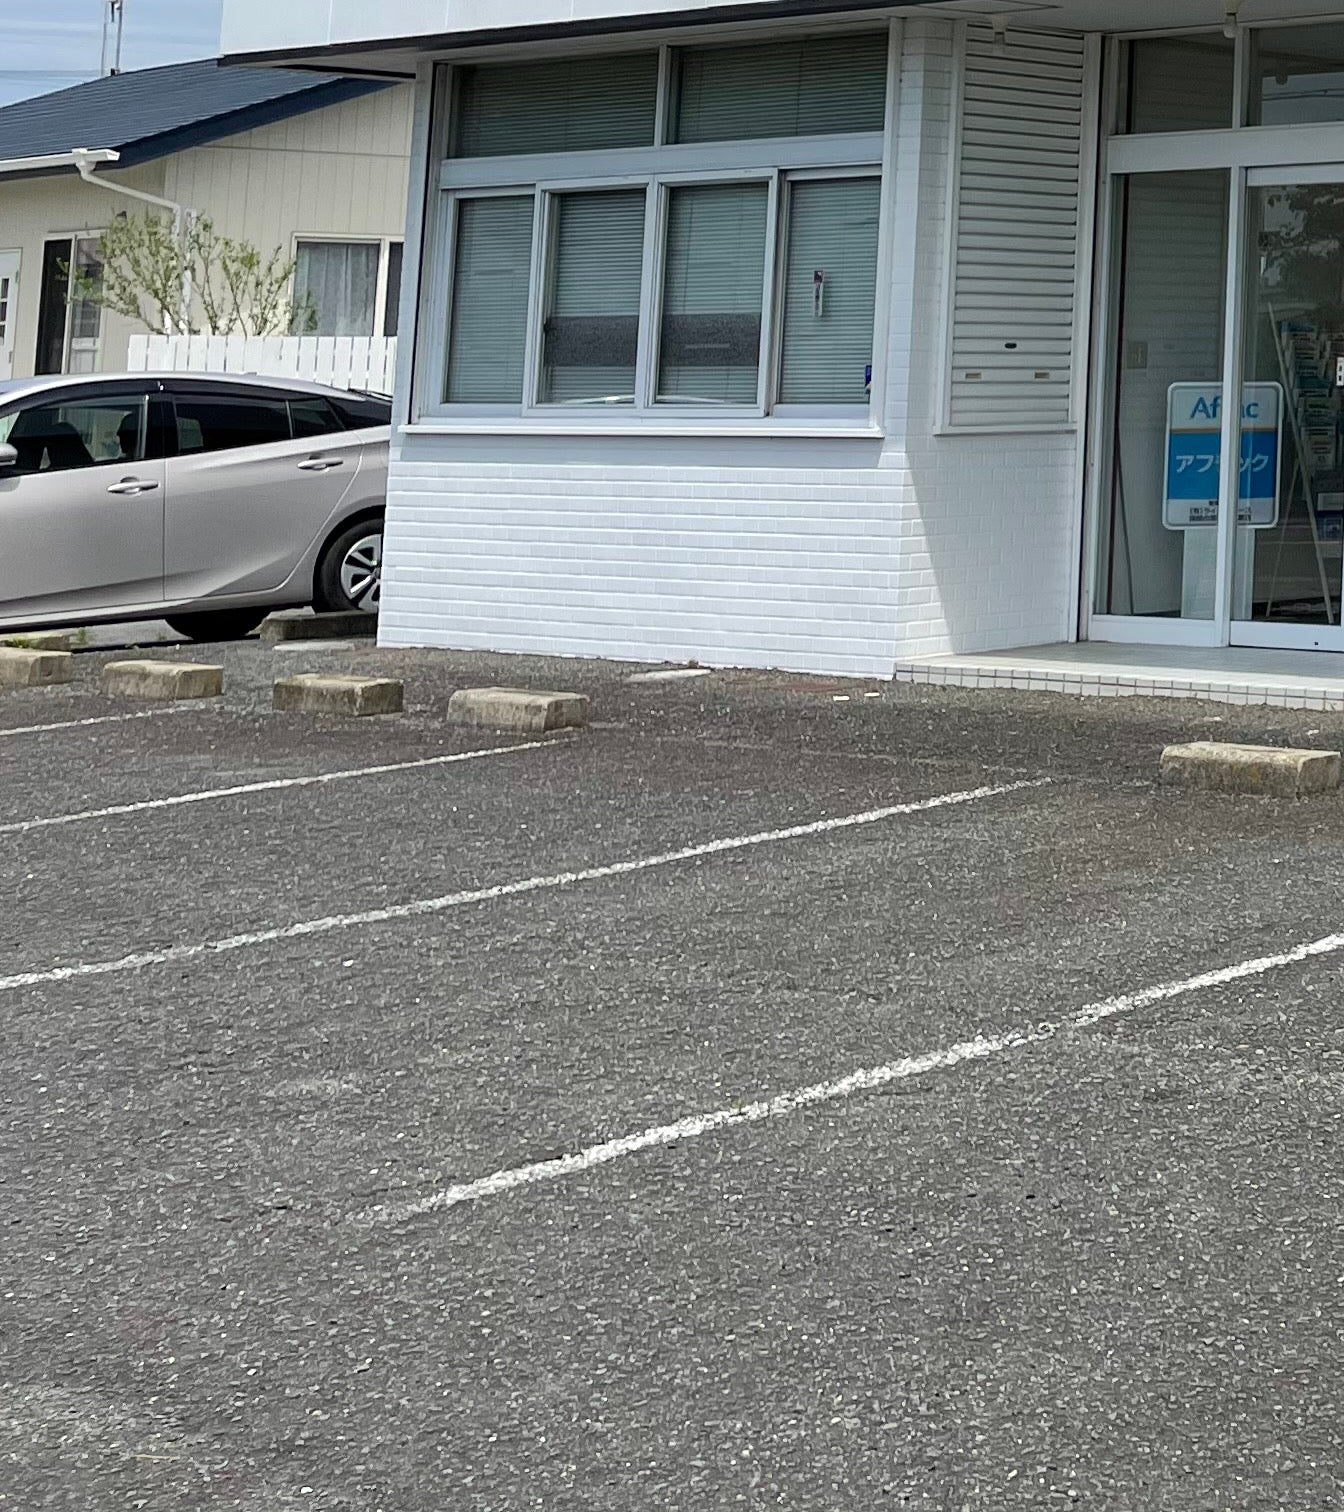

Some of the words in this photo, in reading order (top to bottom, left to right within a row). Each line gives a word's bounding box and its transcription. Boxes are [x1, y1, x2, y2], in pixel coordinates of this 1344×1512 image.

[1190, 396, 1259, 419] Afc
[1175, 453, 1269, 473] アフック
